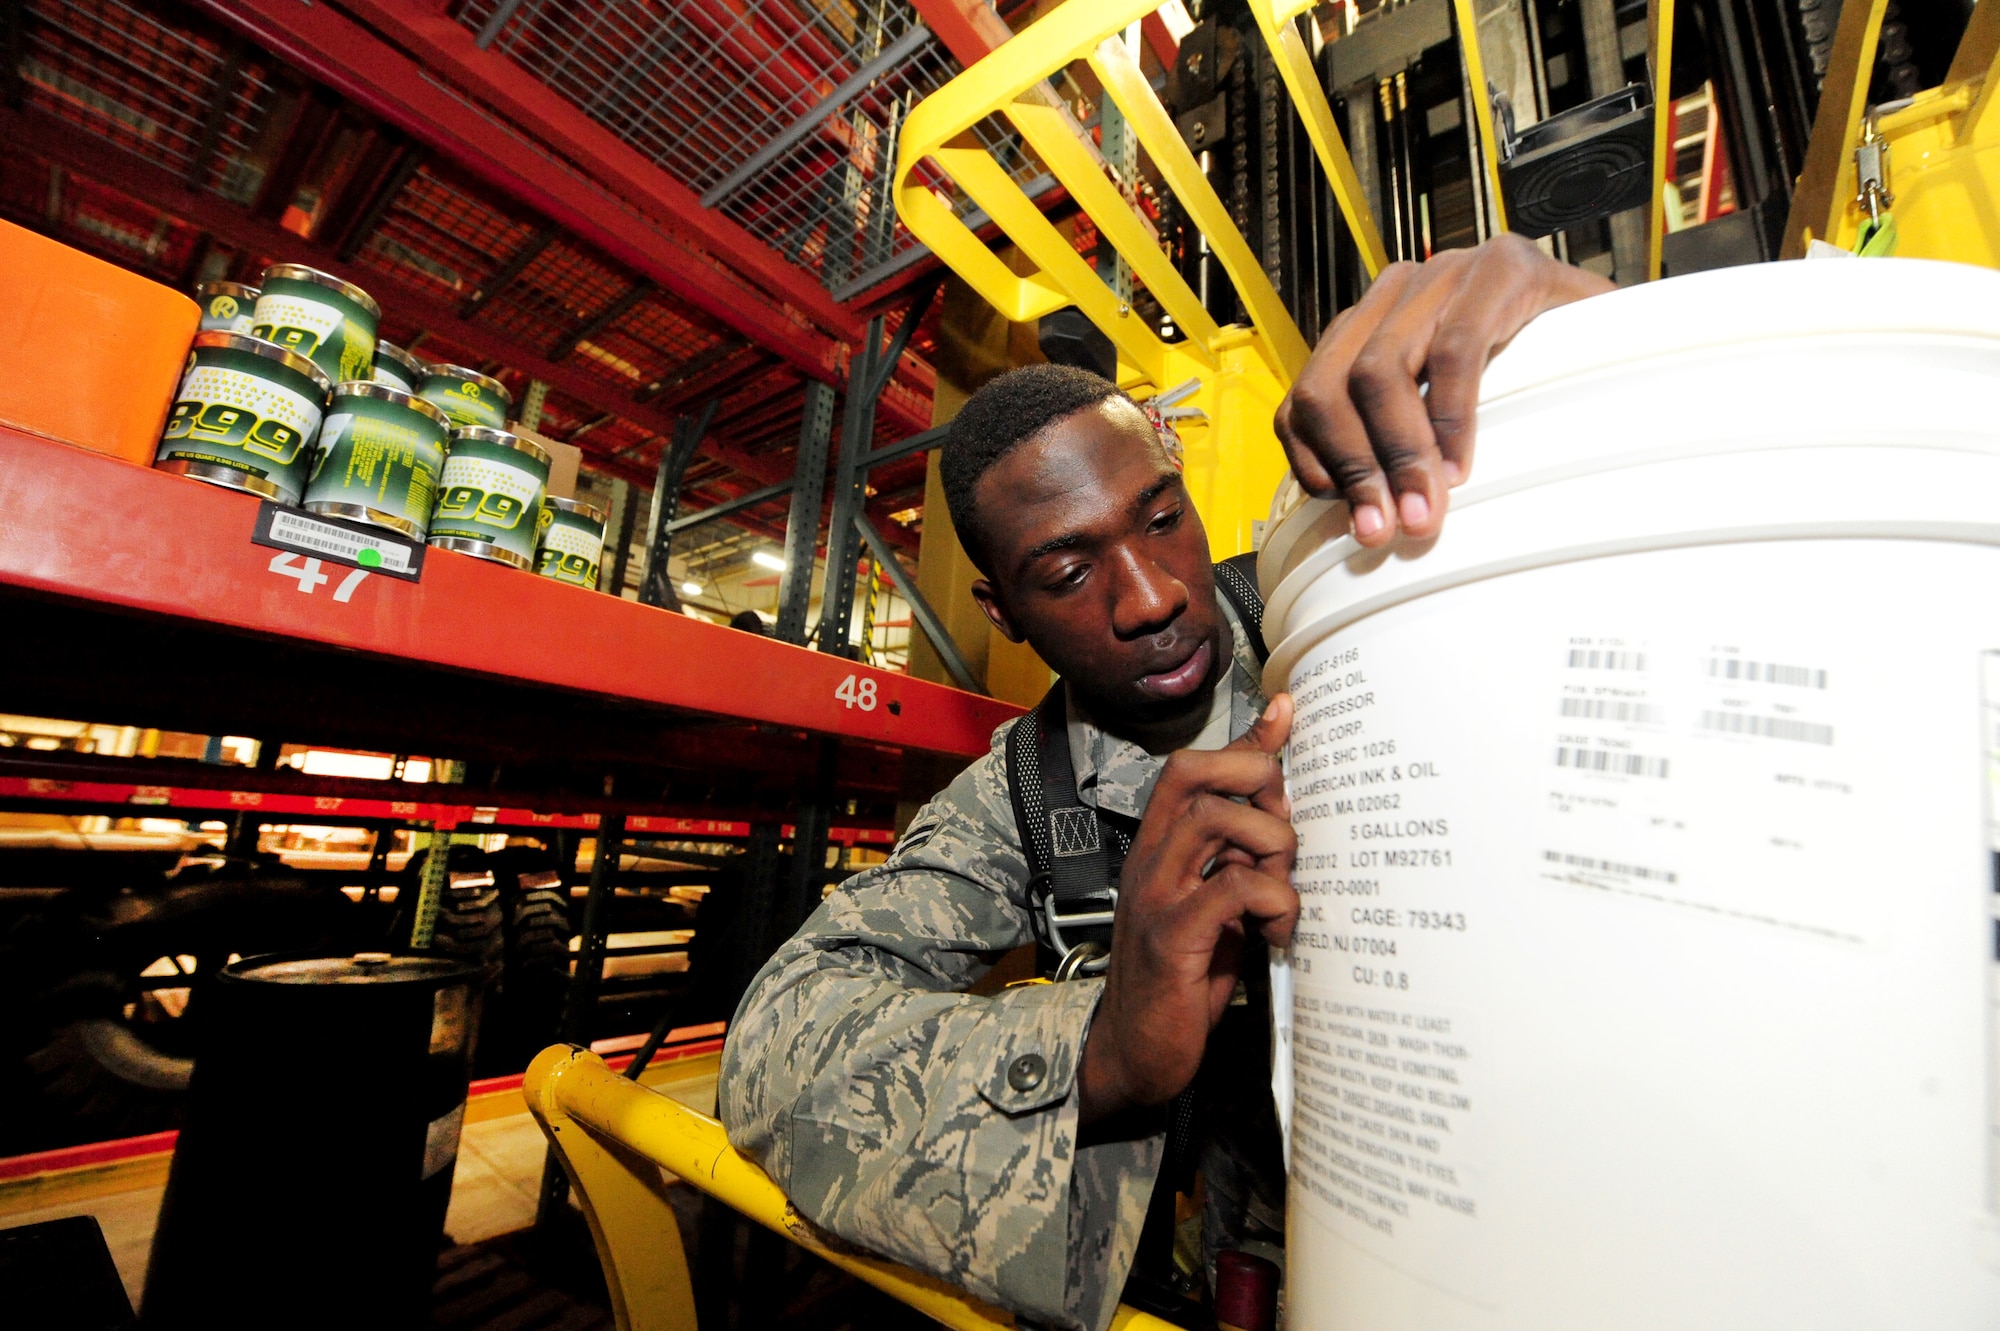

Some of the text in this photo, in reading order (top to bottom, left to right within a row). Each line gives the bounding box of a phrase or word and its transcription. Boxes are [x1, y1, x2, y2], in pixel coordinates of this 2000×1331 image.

[200, 368, 254, 384] ROYCO
[190, 384, 262, 402] AIRCRAFT
[195, 377, 294, 407] LUBRICATING
[186, 391, 292, 423] TURBINE OIL
[163, 400, 304, 466] 899
[195, 453, 216, 463] QUART
[232, 460, 250, 471] LITER
[268, 551, 370, 604] 47
[1345, 670, 1367, 687] OIL
[834, 674, 878, 712] 48
[1301, 692, 1376, 731] COMPRESSOR
[1311, 734, 1327, 748] OIL
[1328, 720, 1365, 743] CORP.
[1301, 756, 1329, 774] RARUS
[1332, 747, 1358, 766] SHC
[1362, 740, 1396, 759] 1026
[1360, 767, 1385, 785] INK
[1391, 765, 1402, 781] &
[1408, 762, 1440, 780] OIL
[1335, 800, 1354, 816] MA
[1357, 794, 1401, 812] 02062
[1350, 819, 1449, 841] 5 GALLONS
[1350, 851, 1378, 868] LOT
[1383, 850, 1453, 868] M92761
[1351, 907, 1402, 927] CAGE:
[1408, 910, 1467, 932] 79343
[1334, 935, 1350, 952] NJ
[1352, 937, 1397, 956] 07004
[1353, 966, 1378, 985] CU:
[1383, 970, 1409, 990] 0.8
